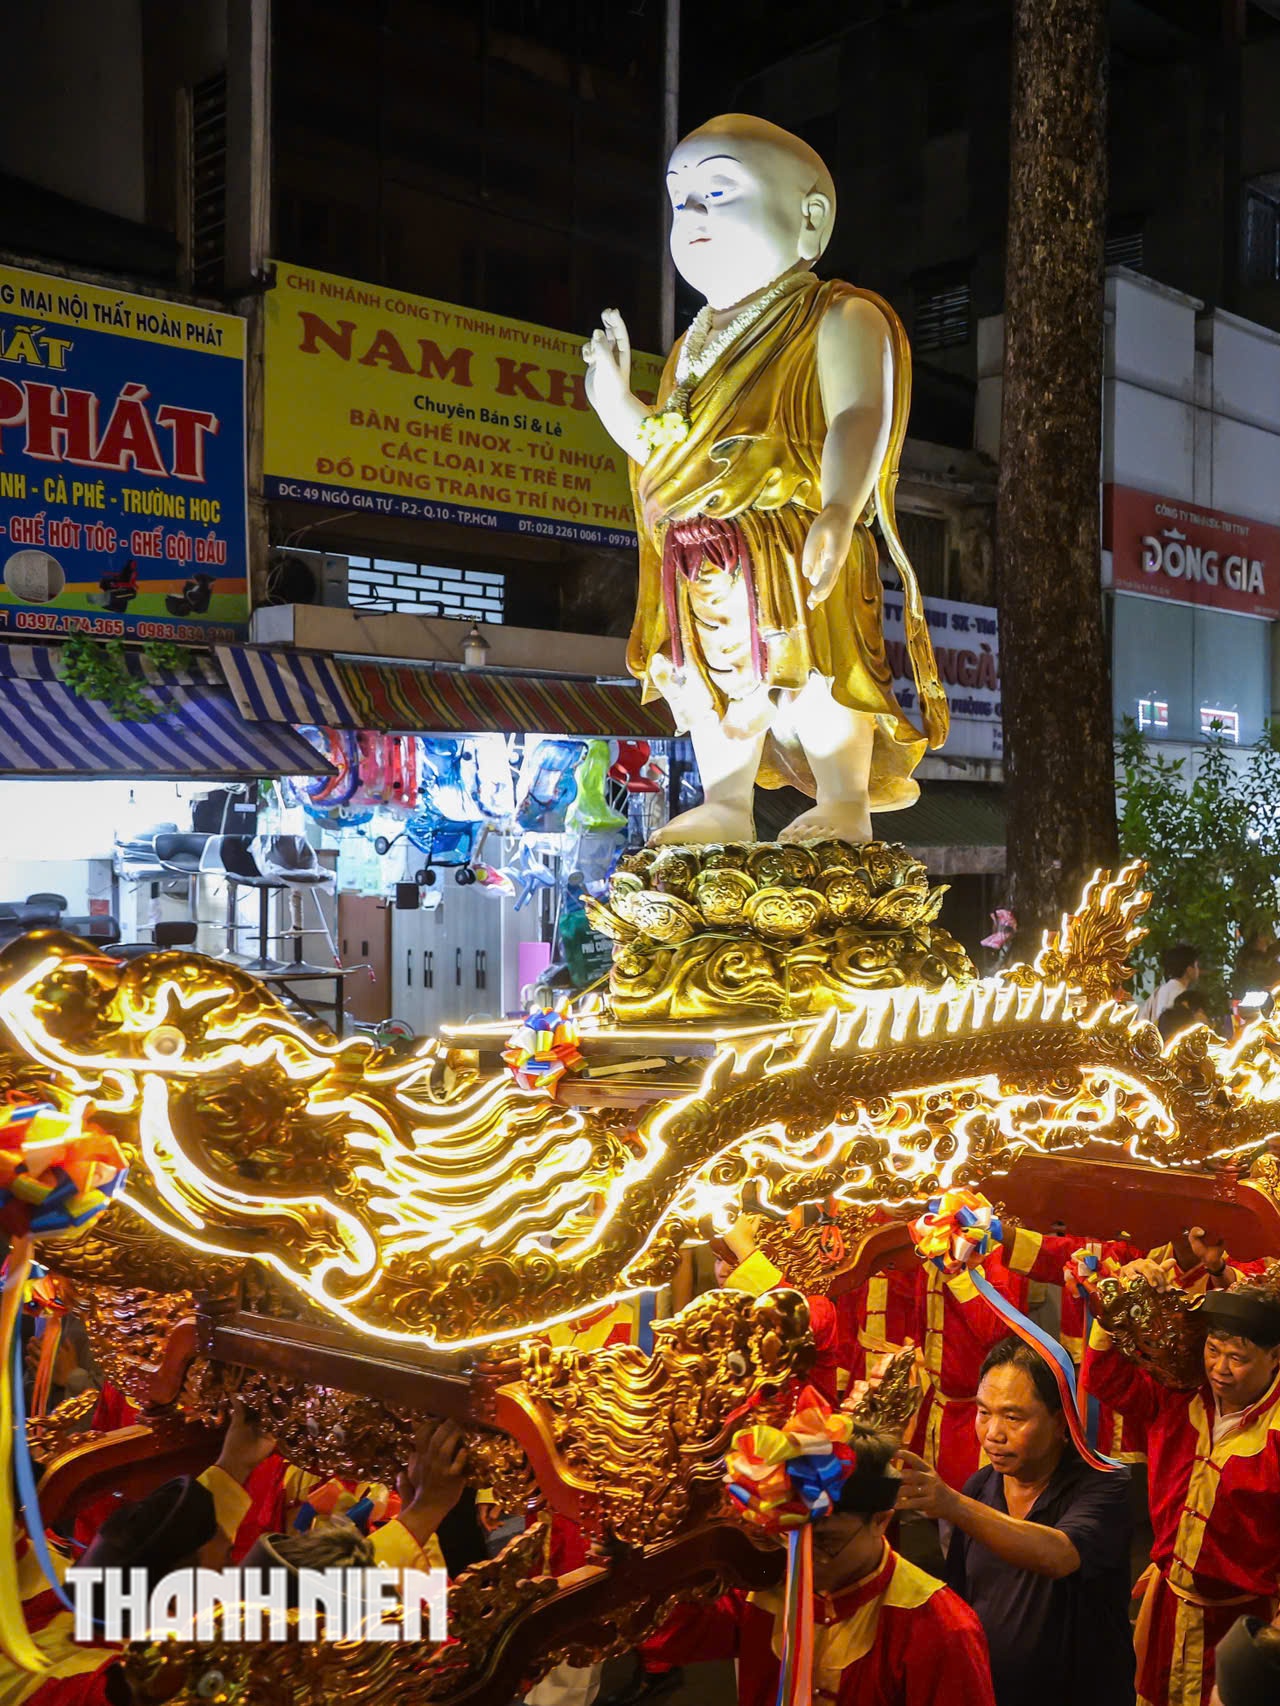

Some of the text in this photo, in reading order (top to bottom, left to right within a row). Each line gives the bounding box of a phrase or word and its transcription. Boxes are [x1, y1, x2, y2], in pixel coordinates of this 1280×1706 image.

[21, 289, 52, 316] MẠI
[59, 295, 88, 323] NỘI
[94, 301, 131, 329] THẤT
[137, 313, 181, 340] HOÀN
[187, 323, 223, 347] PHÁT
[287, 274, 315, 293] CHI
[320, 283, 381, 309] NHÁNH
[384, 299, 430, 321] CÔNG
[433, 310, 451, 326] TY
[454, 315, 496, 337] TNHH
[499, 326, 531, 345] MTV
[533, 333, 569, 354] PHÁT
[0, 325, 73, 371] ẤT
[298, 311, 474, 388] NAM
[349, 409, 400, 433] BÀN
[406, 421, 453, 444] GHẾ
[458, 430, 511, 454] INOX
[528, 441, 553, 462] TỦ
[560, 448, 616, 475] NHỰA
[414, 395, 562, 438] Chuyên Bán Sỉ & Lẻ
[361, 464, 431, 492] DÙNG
[435, 476, 512, 504] TRANG
[515, 489, 548, 510] TRÍ
[552, 494, 589, 518] NỘI
[381, 441, 592, 493] CÁC LOẠI XE TRẺ EM
[1, 472, 26, 499] NH
[44, 474, 68, 505] CÀ
[72, 480, 105, 510] PHÊ
[122, 488, 185, 520] TRƯỜNG
[190, 499, 221, 528] HỌC
[278, 482, 301, 498] ĐC:
[303, 487, 319, 500] 49
[321, 489, 350, 506] NGÔ
[352, 496, 374, 509] GIA
[376, 498, 393, 514] TỰ
[424, 506, 450, 520] Q.10
[457, 510, 498, 527] TP.HCM
[518, 519, 536, 533] ĐT:
[536, 521, 554, 535] 028
[556, 526, 578, 539] 2261
[580, 529, 601, 542] 0061
[608, 534, 630, 546] 0979
[632, 537, 638, 548] 6
[10, 511, 45, 546] GHẾ
[49, 516, 81, 550] HỚT
[84, 521, 116, 554] TÓC
[131, 526, 164, 559] GHẾ
[166, 531, 192, 567] GỘI
[1223, 555, 1265, 596] GIA
